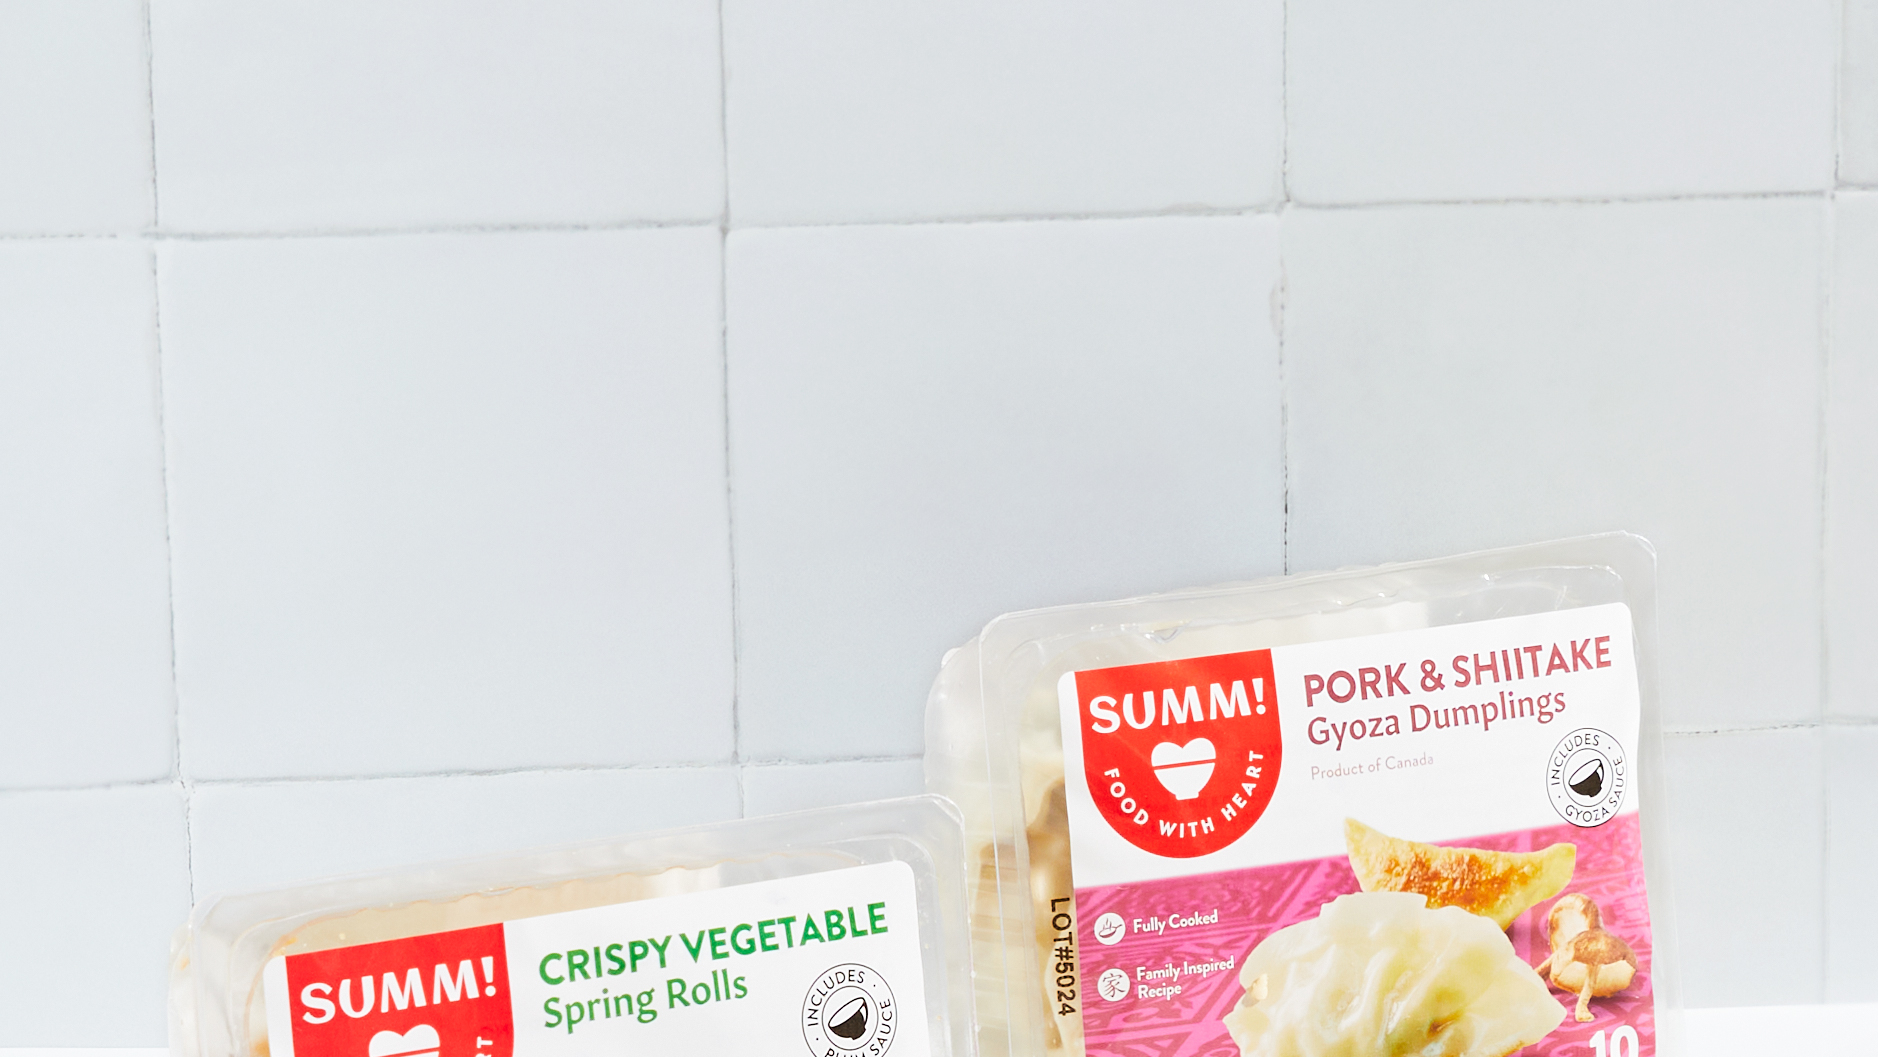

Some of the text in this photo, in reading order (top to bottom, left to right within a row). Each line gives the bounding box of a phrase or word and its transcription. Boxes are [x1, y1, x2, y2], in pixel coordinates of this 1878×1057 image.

[1304, 635, 1612, 708] PORK & SHIITAKE
[1089, 678, 1266, 734] SUMM!
[1307, 690, 1566, 751] Gyoza Dumplings
[1311, 752, 1434, 780] Product of Canada
[1551, 734, 1600, 785] INCLUDES
[1565, 756, 1624, 822] GYOZA SAUCE
[1104, 750, 1264, 838] FOOD WITH HEART
[538, 901, 889, 985] CRISPY VEGETABLE
[1133, 909, 1218, 935] Fully Cooked
[1050, 897, 1076, 1016] LOT#5024
[1136, 955, 1235, 982] Family Inspired
[301, 956, 496, 1025] SUMM!
[543, 968, 748, 1034] Spring Rolls
[807, 970, 865, 1026] INCLUDES
[1138, 983, 1182, 1000] Recipe
[870, 999, 892, 1056] SAUCE
